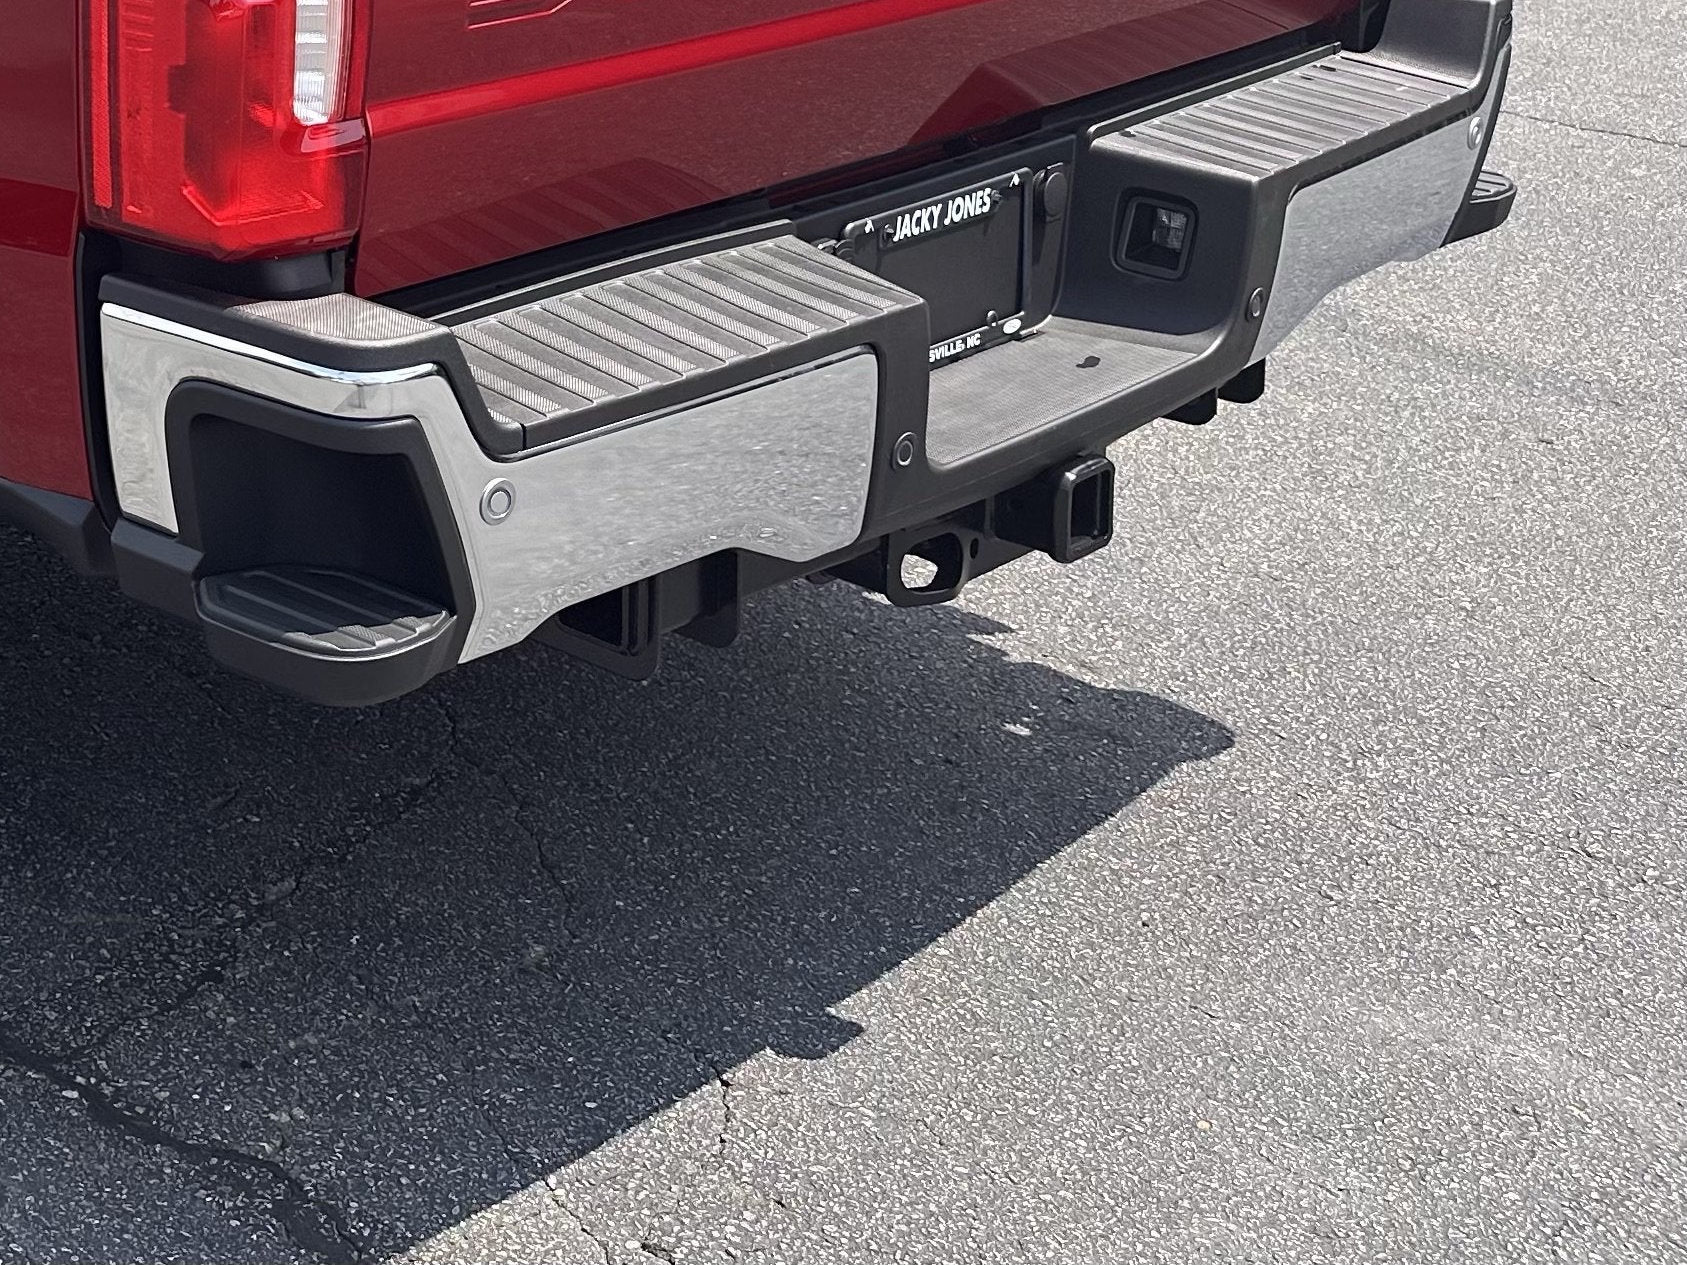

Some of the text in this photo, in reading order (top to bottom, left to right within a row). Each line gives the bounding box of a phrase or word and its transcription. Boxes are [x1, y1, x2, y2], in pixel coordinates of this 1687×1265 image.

[892, 187, 992, 242] JACKY JONES
[928, 333, 981, 363] SVILLE, NC
